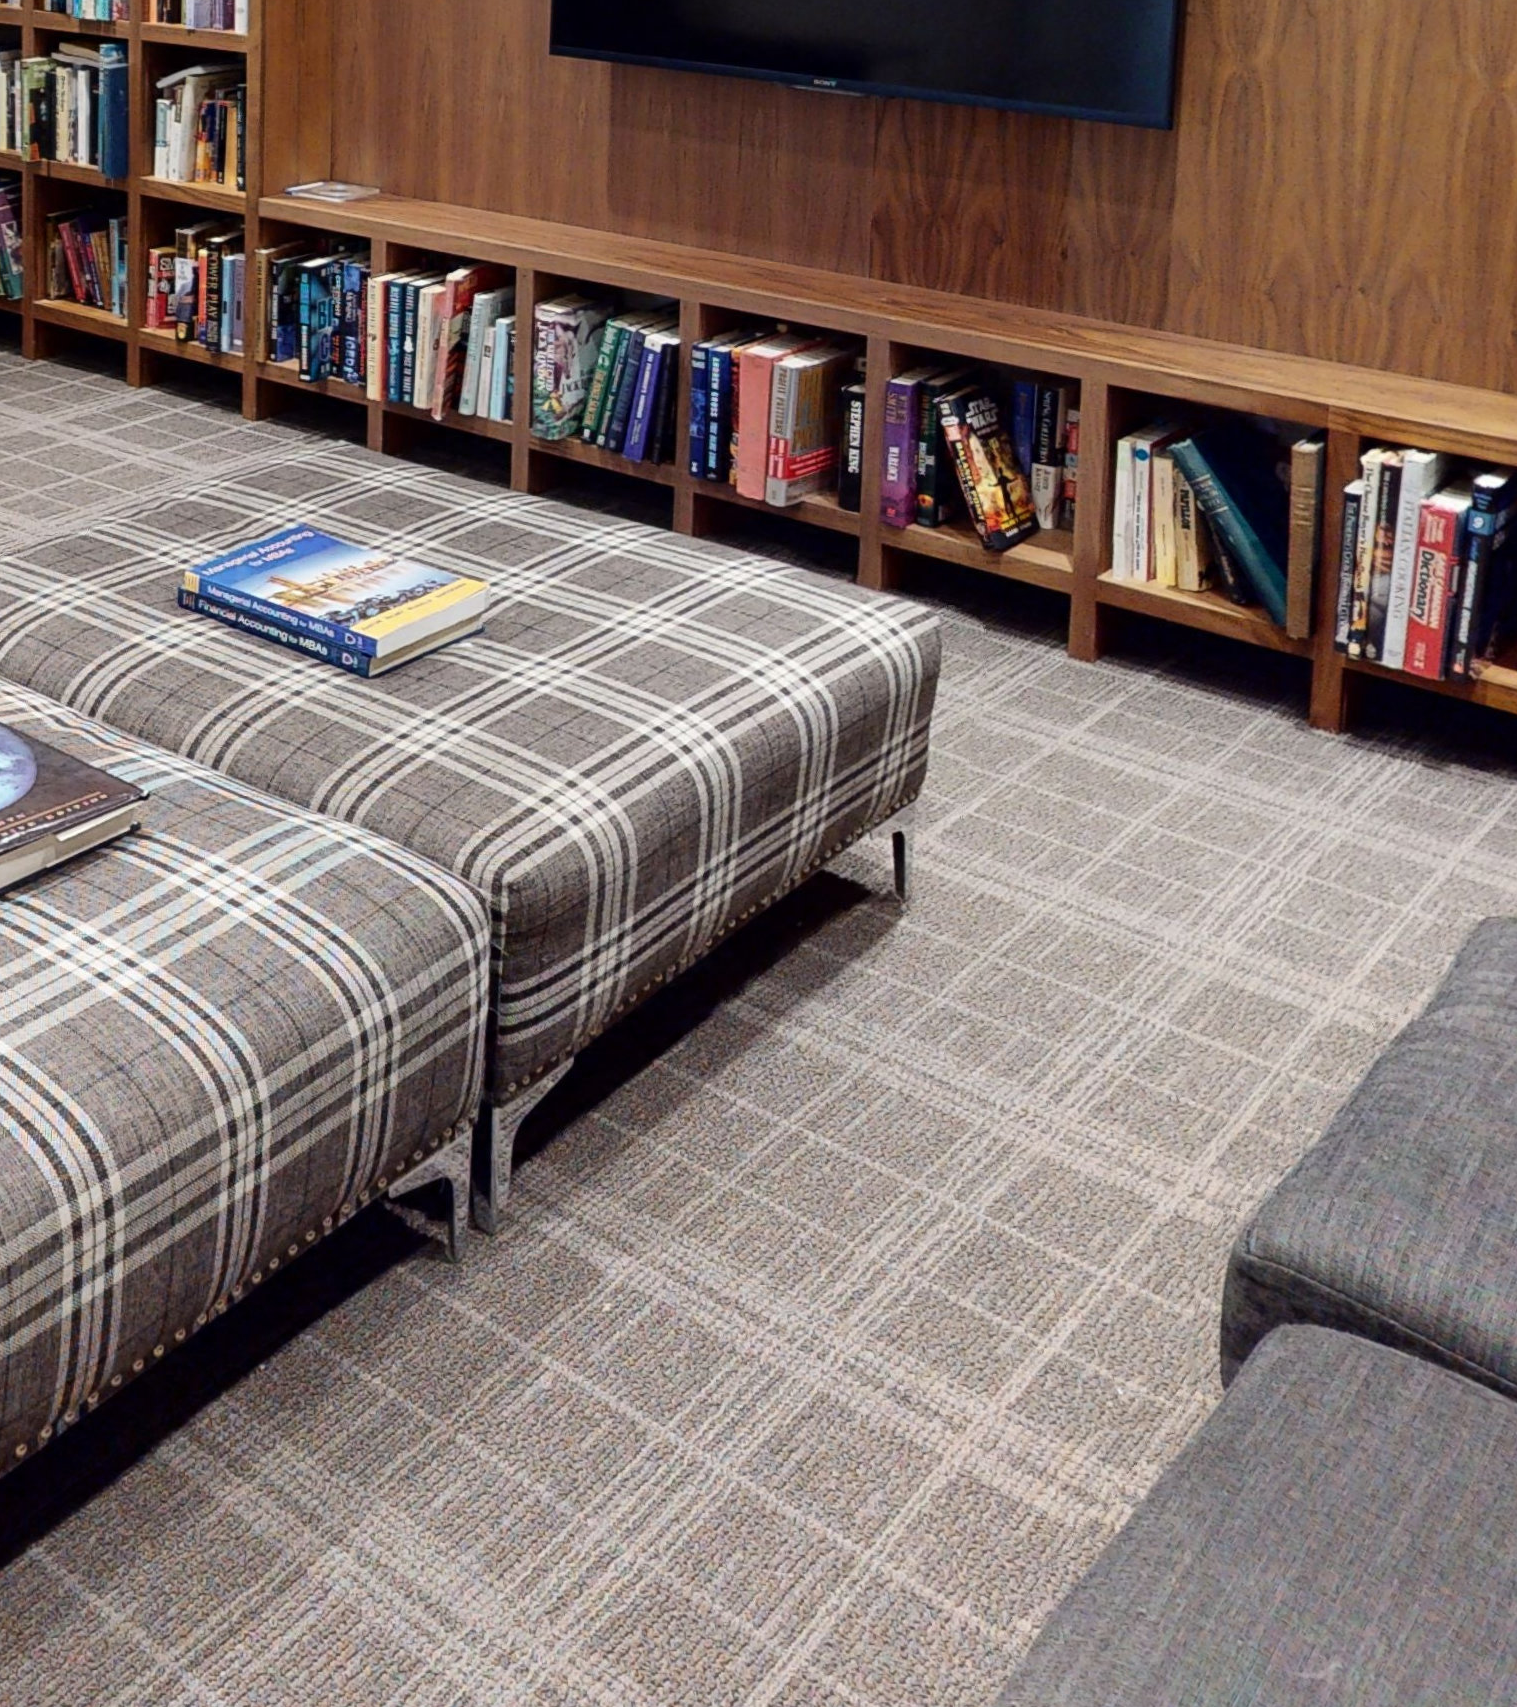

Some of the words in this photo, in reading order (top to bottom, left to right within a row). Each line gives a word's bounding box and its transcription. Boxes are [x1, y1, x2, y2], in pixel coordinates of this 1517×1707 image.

[813, 78, 837, 87] SONY
[206, 250, 220, 289] POWER
[205, 293, 218, 317] PLAY
[848, 400, 862, 447] STEPHEN
[885, 392, 898, 424] SMITH
[966, 397, 995, 418] STAR
[966, 409, 998, 430] WARS
[847, 448, 860, 474] KING
[1397, 500, 1416, 556] ITALIAN
[1391, 557, 1411, 618] COOKING
[1409, 548, 1434, 623] Dictionary
[197, 598, 237, 623] Financial
[237, 609, 289, 644] Accounting
[298, 634, 329, 657] MBAs
[206, 584, 251, 611] Managerial
[251, 598, 299, 628] Accounting
[308, 619, 336, 640] MBAs
